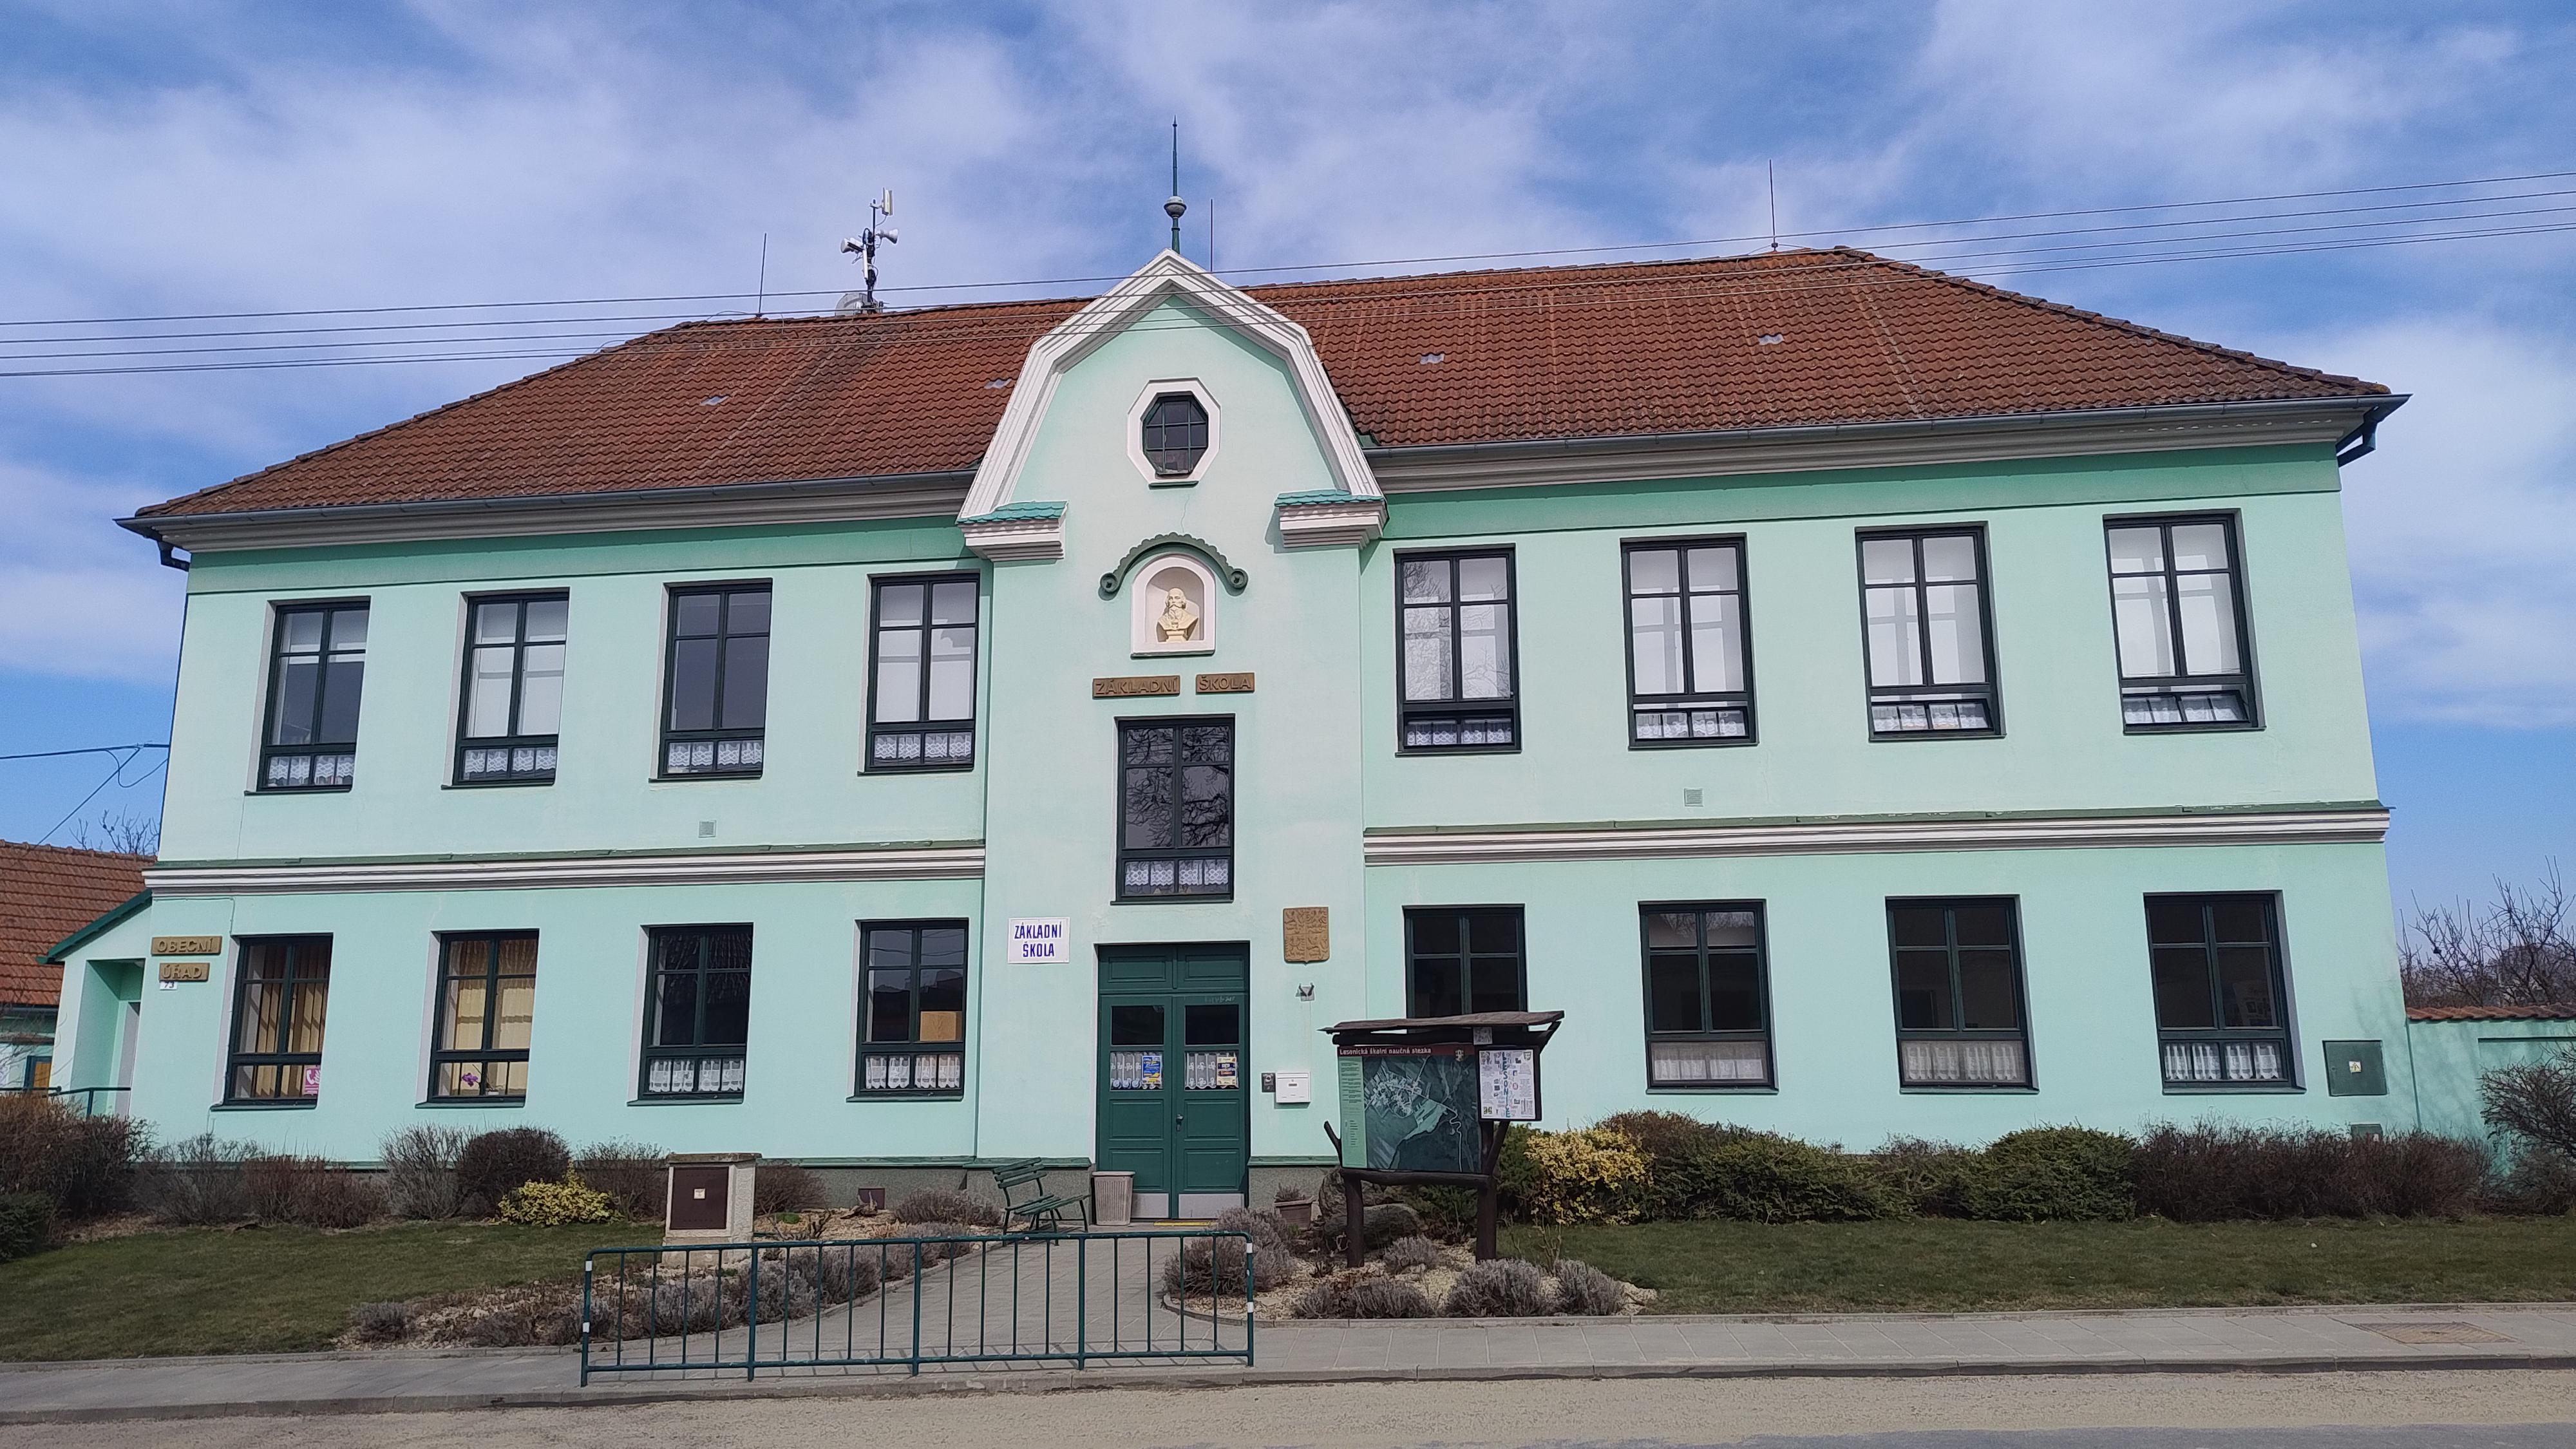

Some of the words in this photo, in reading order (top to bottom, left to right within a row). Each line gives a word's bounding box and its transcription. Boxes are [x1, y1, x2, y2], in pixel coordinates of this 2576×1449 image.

[1095, 679, 1178, 695] ZÁKLADNÍ
[1199, 676, 1251, 690] ŠKOLA
[1014, 922, 1061, 939] ZÁKLADNÍ
[157, 938, 213, 953] OBECNÍ
[1023, 941, 1054, 957] ŠKOLA
[162, 964, 202, 979] ÚŘAD
